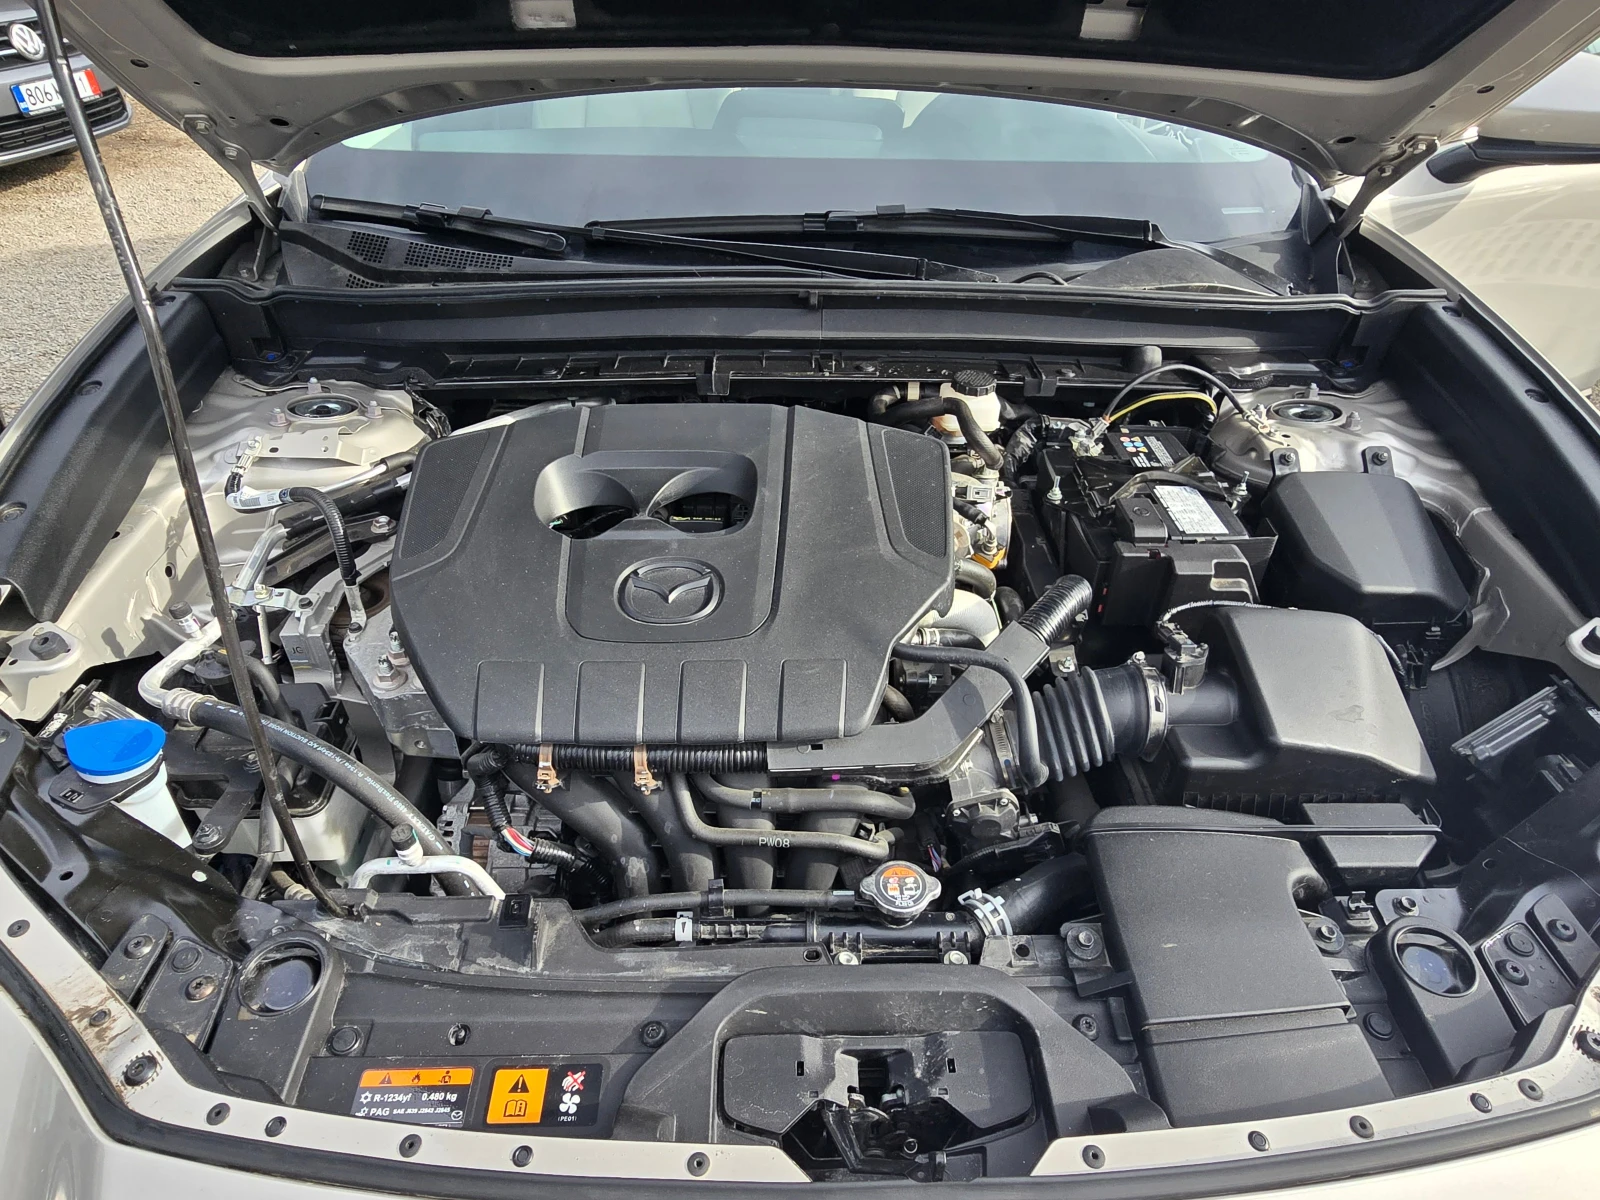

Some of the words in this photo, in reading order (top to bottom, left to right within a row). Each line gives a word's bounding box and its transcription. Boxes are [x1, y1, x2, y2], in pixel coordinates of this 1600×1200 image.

[25, 83, 53, 106] 806
[268, 722, 284, 733] HOSE
[283, 729, 308, 744] SUCTION
[406, 813, 436, 841] GALAXY
[758, 836, 790, 848] PW08
[373, 1093, 412, 1103] R-1234yf
[421, 1092, 444, 1101] 0.480
[445, 1091, 458, 1102] kg
[370, 1108, 390, 1116] PAG
